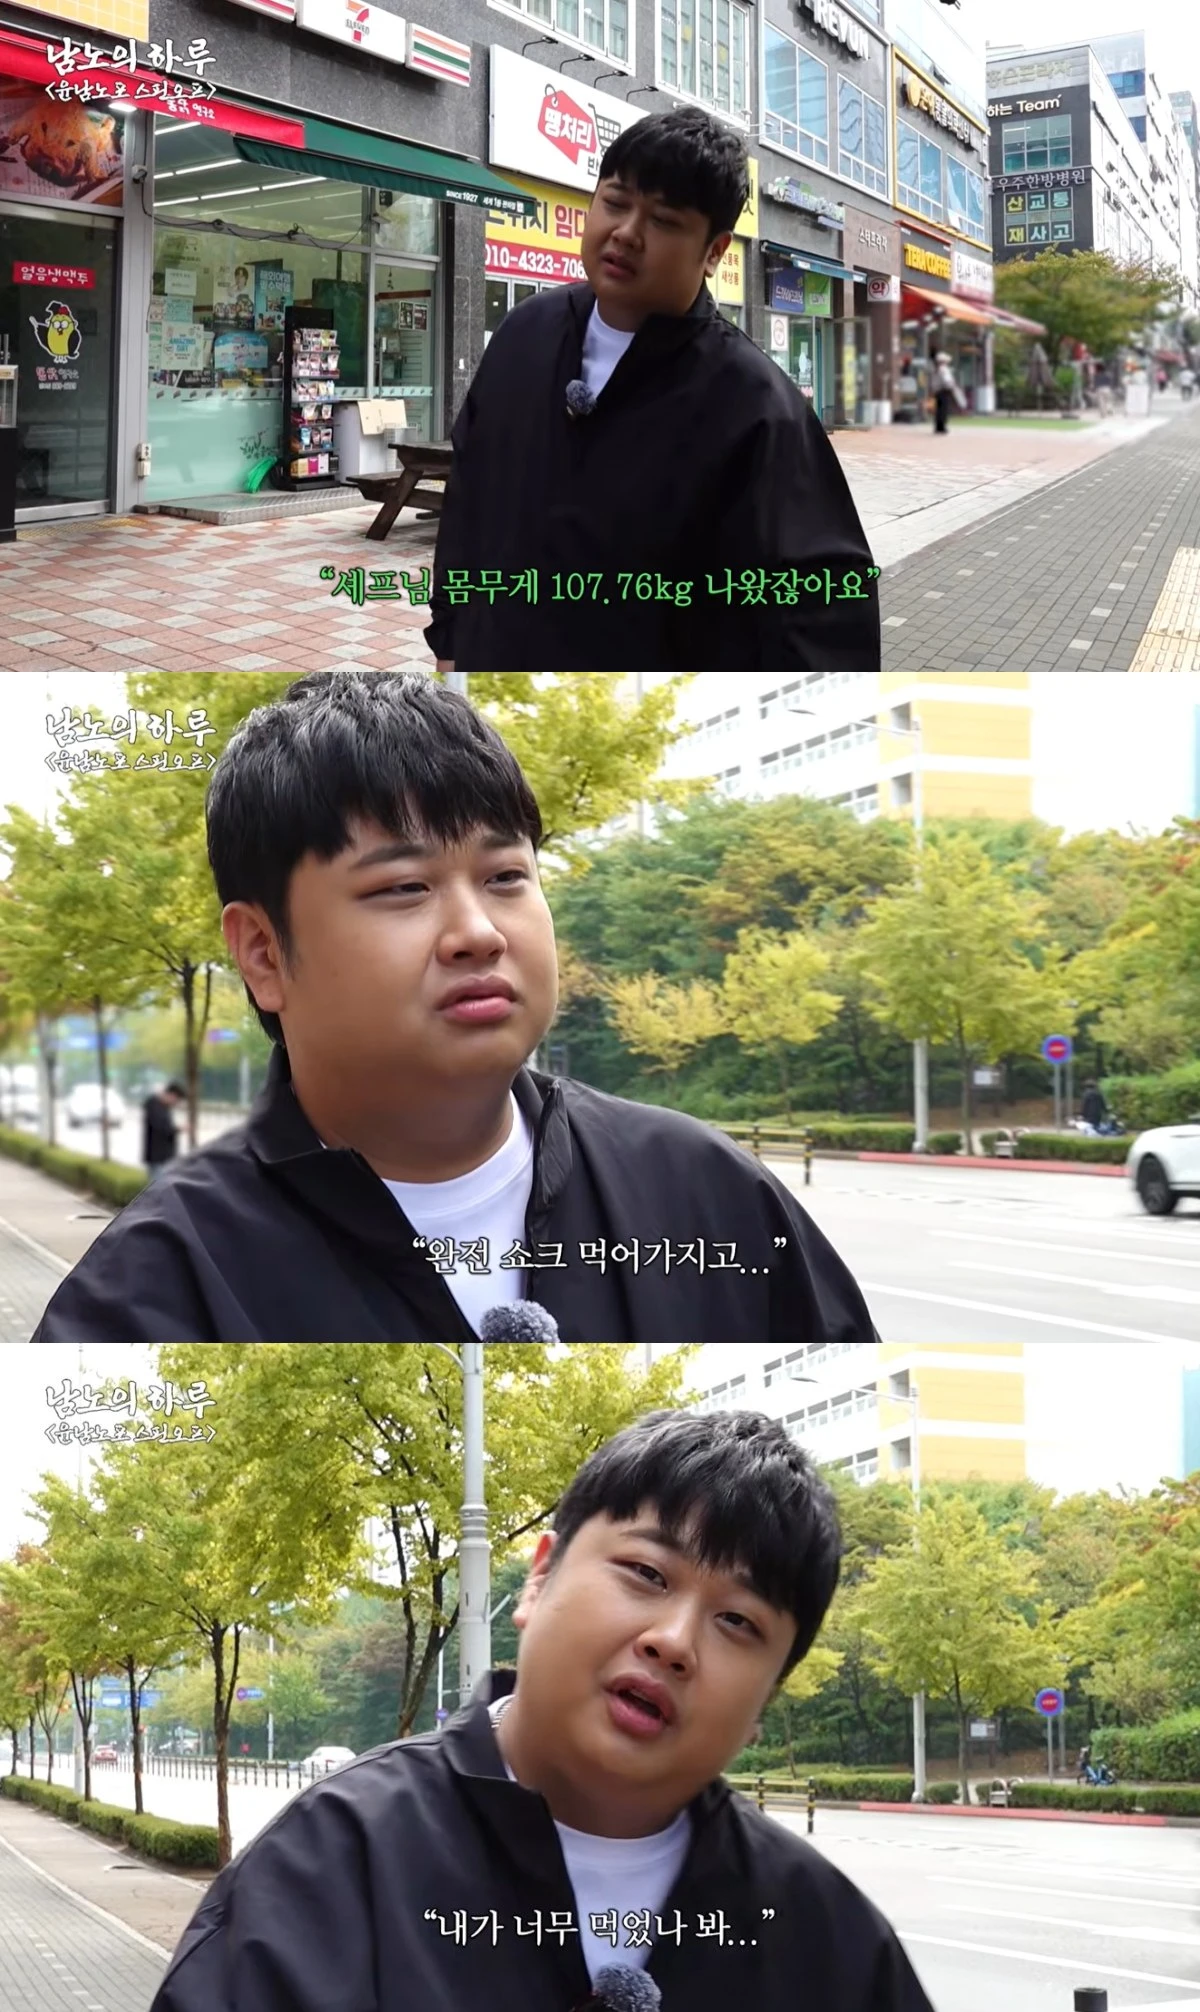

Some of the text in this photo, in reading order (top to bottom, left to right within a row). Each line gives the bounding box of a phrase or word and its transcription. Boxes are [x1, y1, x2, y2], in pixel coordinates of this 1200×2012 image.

[986, 101, 1013, 117] 하는
[544, 106, 593, 149] 땡처리
[997, 169, 1086, 192] 우주한방병원
[484, 243, 588, 280] 010-4323-706
[21, 266, 88, 284] 얼음생맥주
[871, 281, 886, 296] 약
